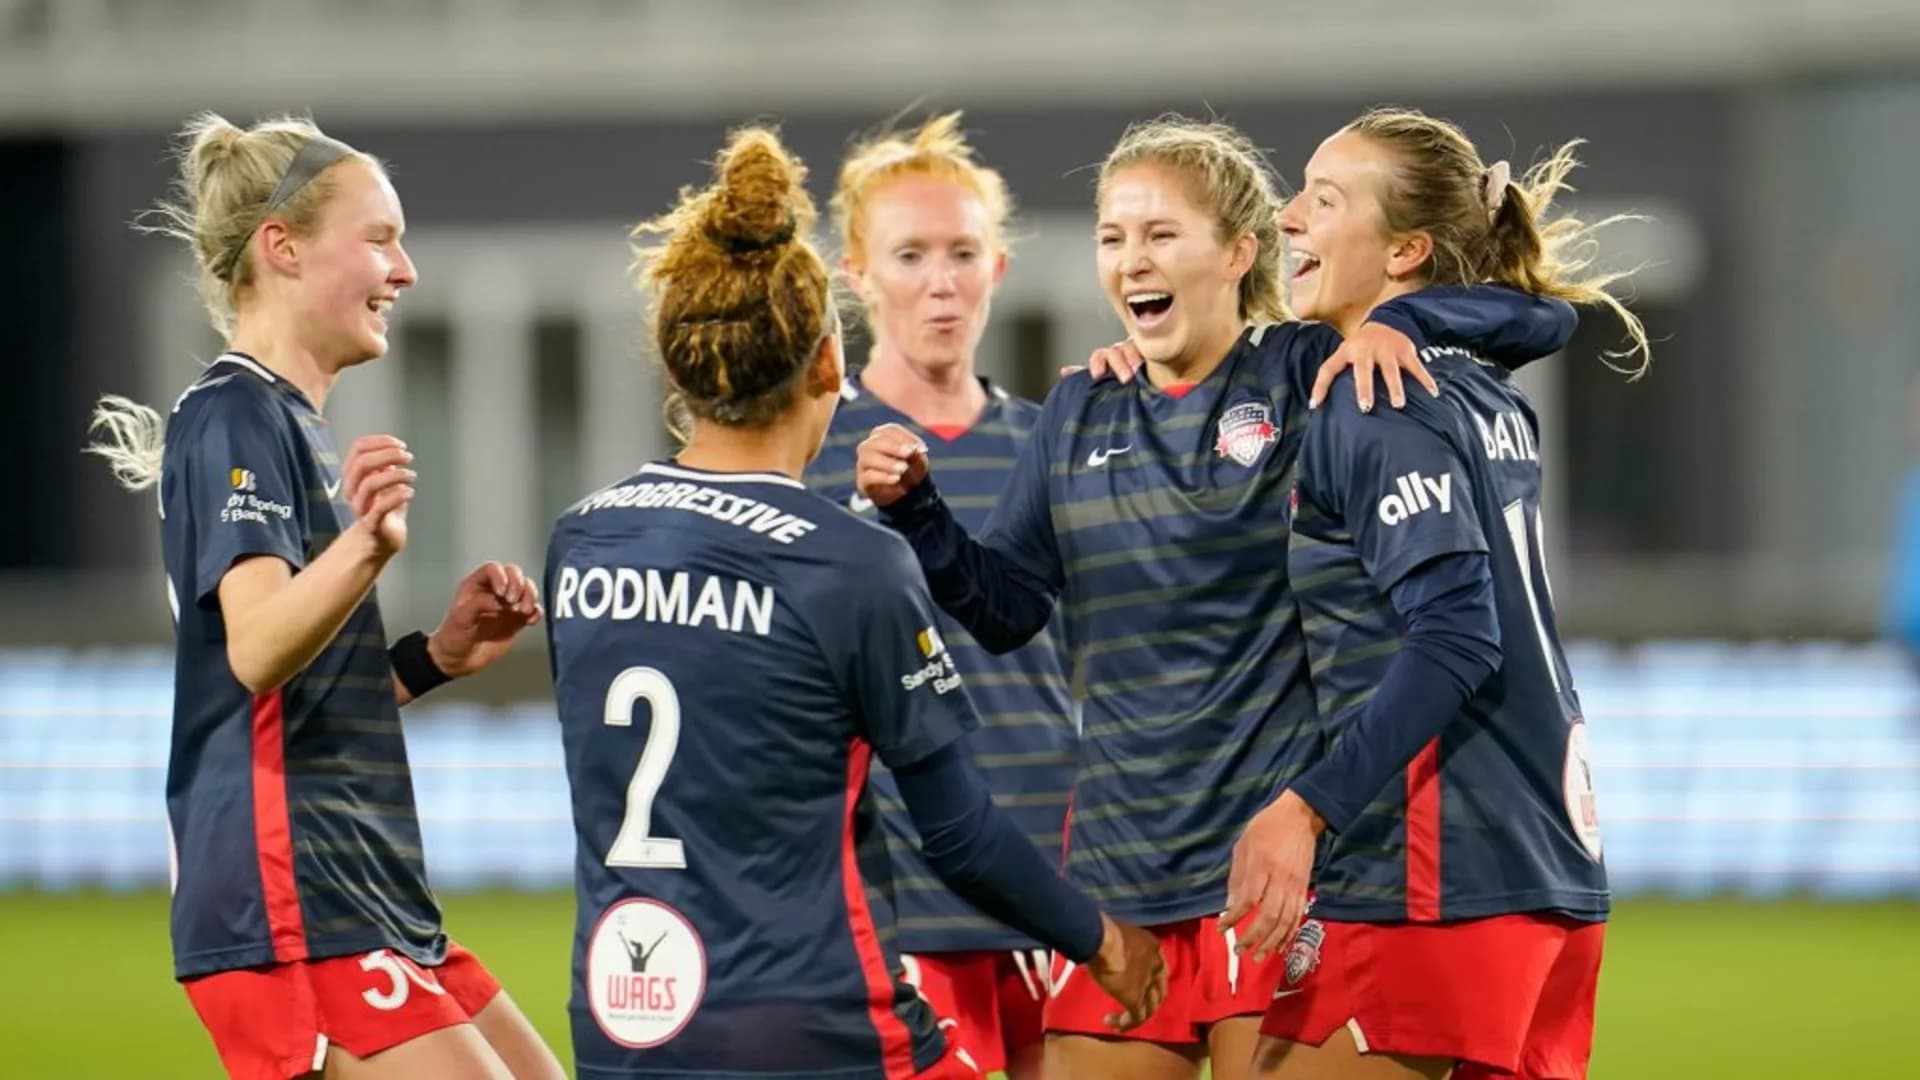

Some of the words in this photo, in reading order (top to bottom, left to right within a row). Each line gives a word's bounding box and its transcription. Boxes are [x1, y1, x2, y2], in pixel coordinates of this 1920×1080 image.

[1379, 470, 1451, 526] ally
[556, 567, 775, 635] RODMAN
[604, 666, 688, 868] 2
[608, 975, 677, 1010] WAGS
